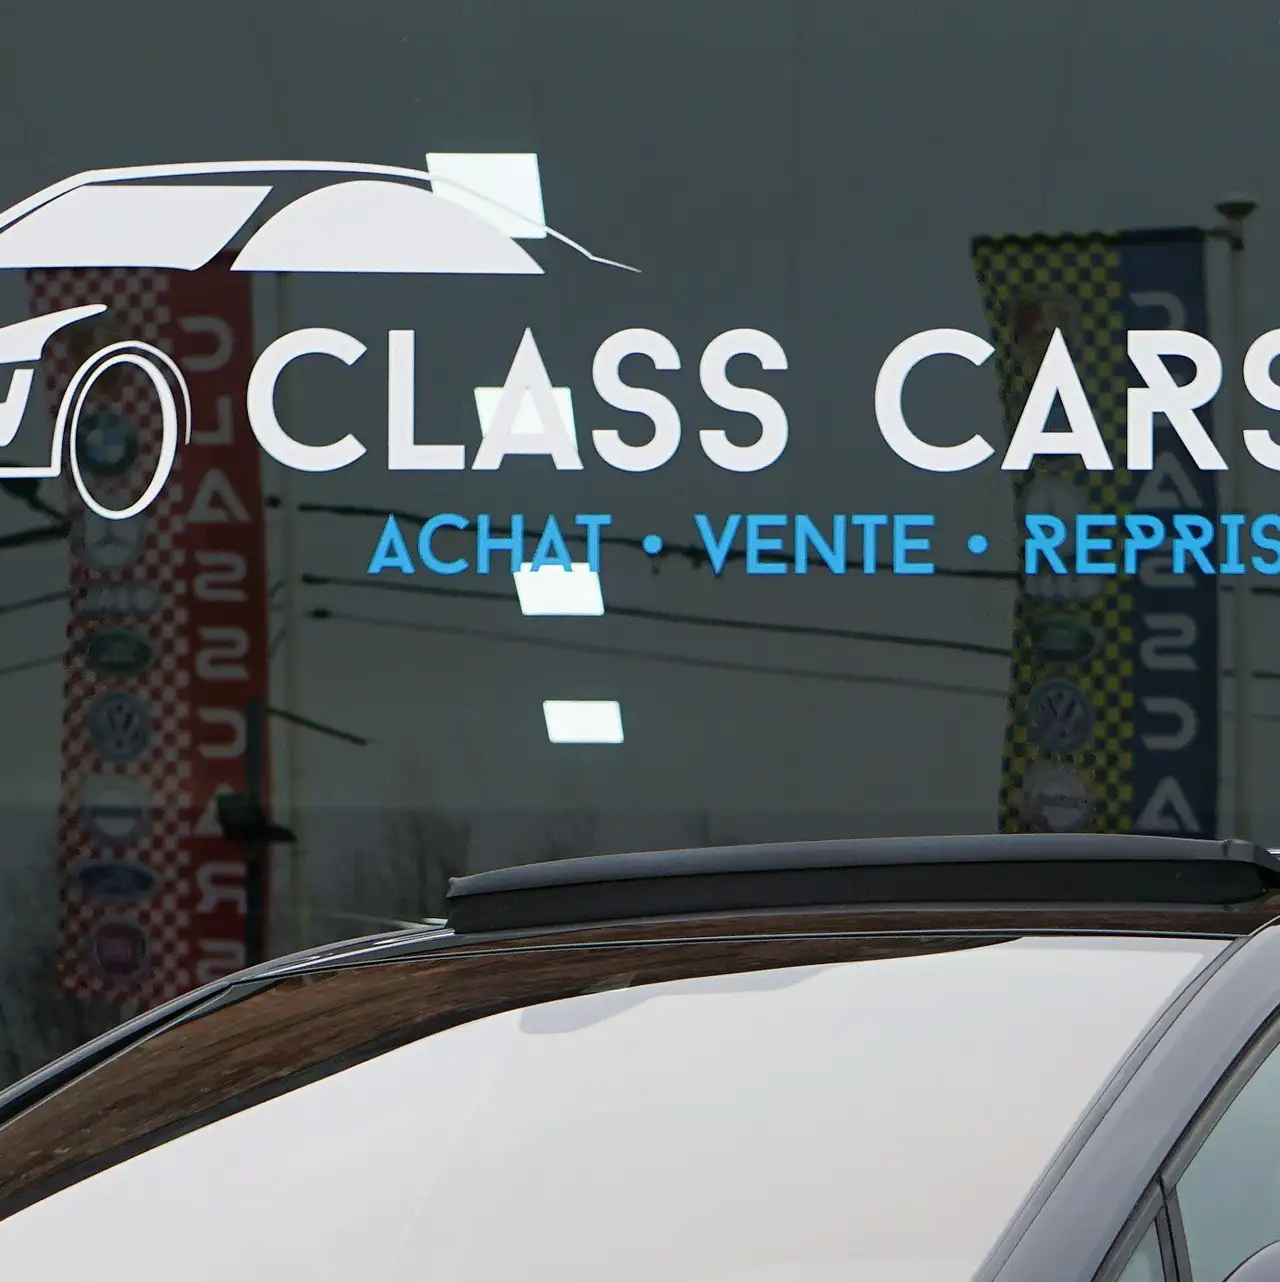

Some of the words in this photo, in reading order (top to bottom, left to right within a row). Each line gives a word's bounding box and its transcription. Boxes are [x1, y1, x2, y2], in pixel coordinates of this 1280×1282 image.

[247, 327, 788, 472] CLASS
[366, 513, 614, 576] ACHAT
[694, 513, 937, 576] VENTE
